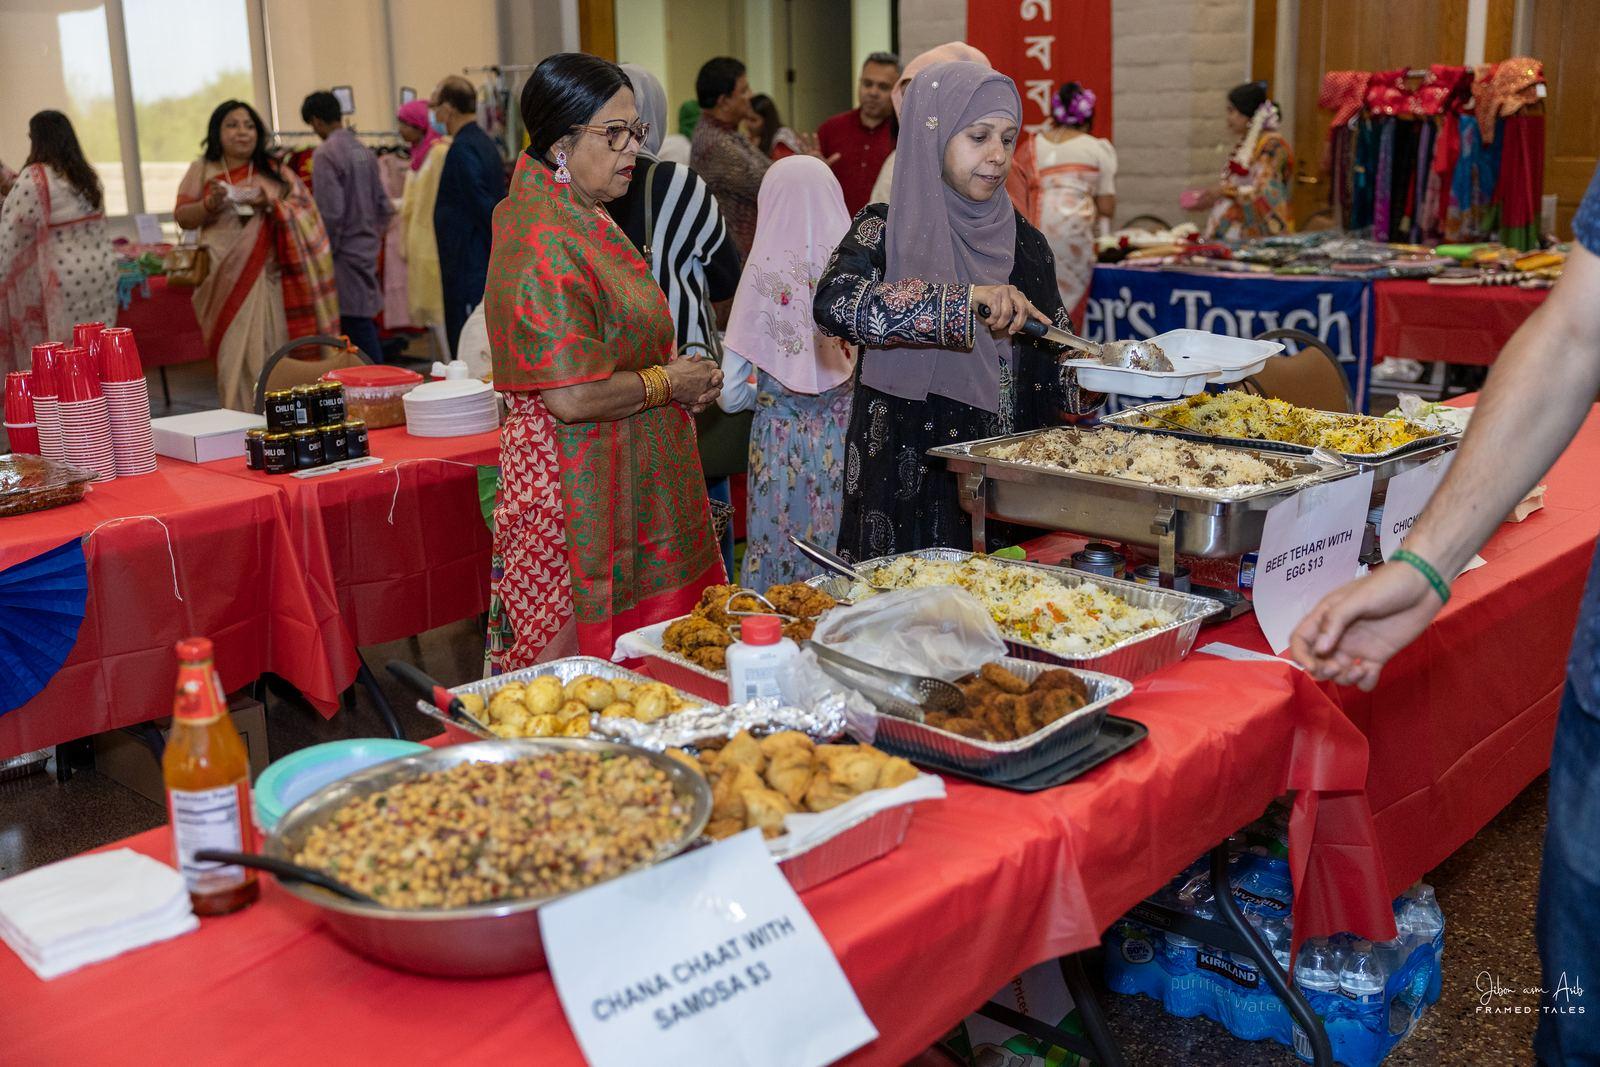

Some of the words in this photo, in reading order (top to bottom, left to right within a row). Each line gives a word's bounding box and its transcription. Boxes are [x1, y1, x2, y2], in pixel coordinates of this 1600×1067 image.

[1168, 288, 1357, 363] Touch
[275, 404, 290, 413] CHILI
[276, 448, 286, 456] OIL
[1265, 551, 1288, 574] BEEF
[1289, 538, 1327, 562] TEHARI
[1327, 529, 1353, 548] WITH
[1286, 562, 1306, 582] EGG
[1307, 555, 1324, 573] $13
[591, 973, 672, 1022] CHANA
[672, 937, 742, 985] CHAAT
[742, 916, 796, 951] WITH
[1200, 953, 1257, 983] KIRKLAND
[653, 974, 748, 1031] SAMOSA
[745, 960, 772, 988] $3
